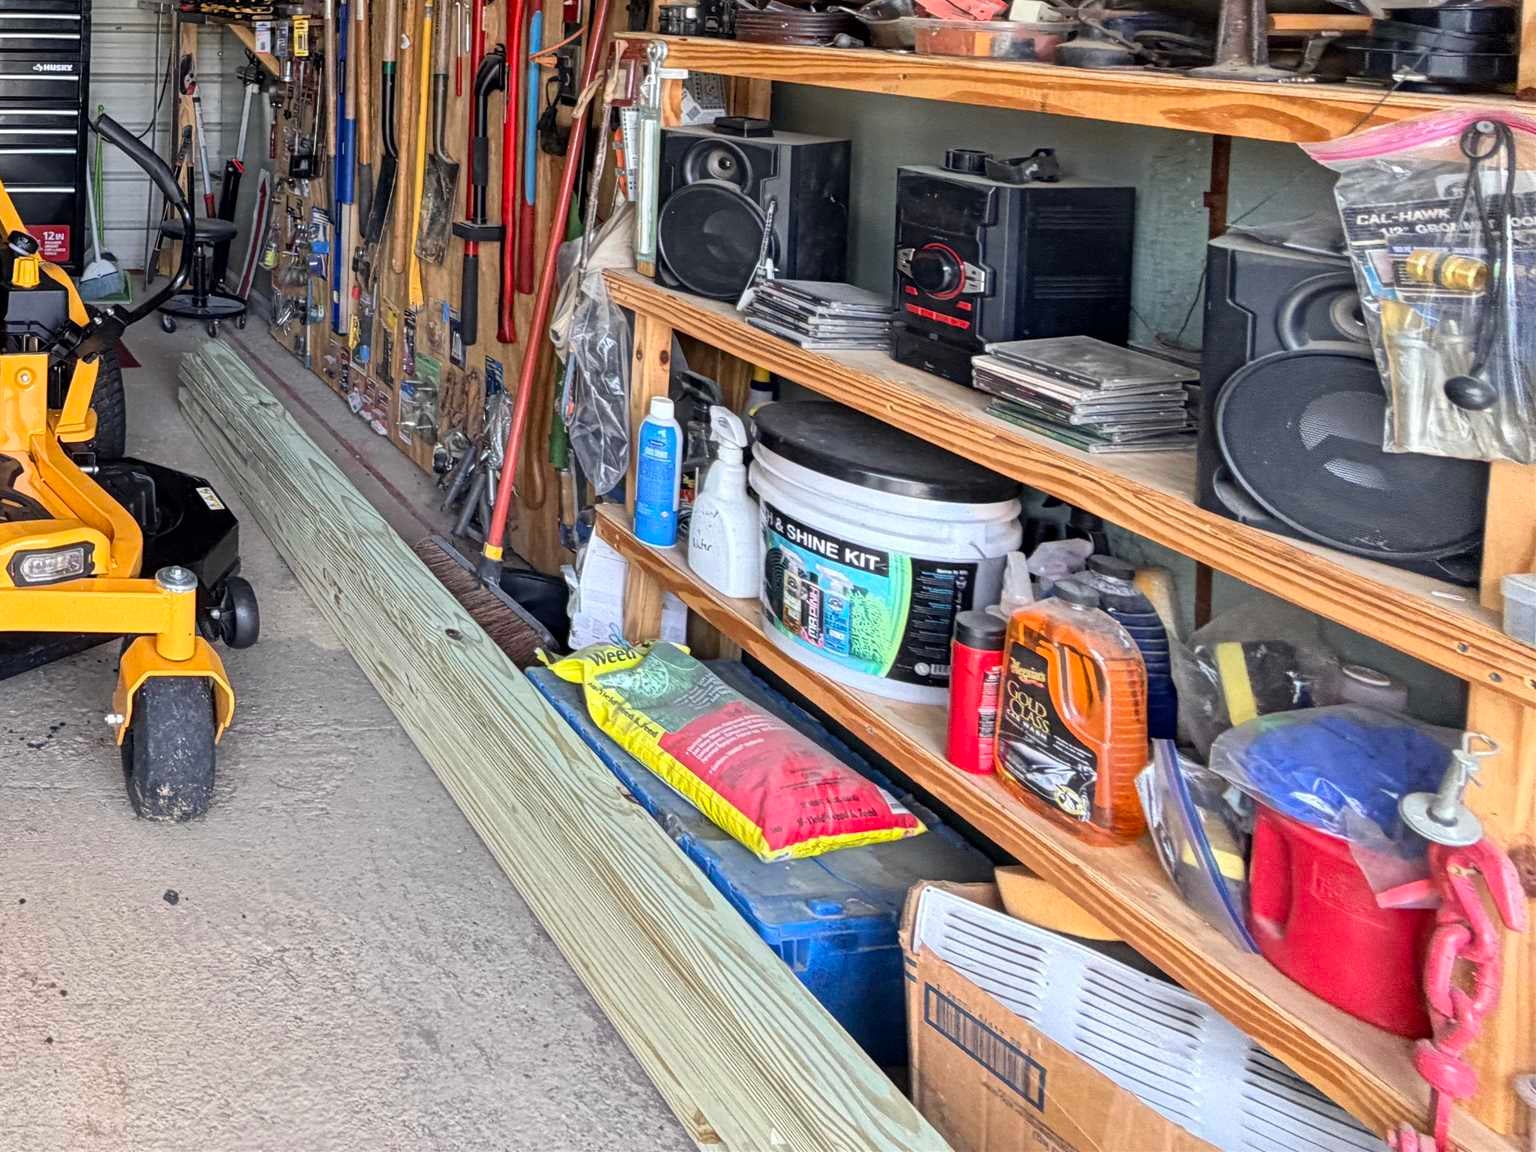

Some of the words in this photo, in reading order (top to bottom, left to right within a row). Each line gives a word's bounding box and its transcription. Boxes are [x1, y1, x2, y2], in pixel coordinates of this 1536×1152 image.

[43, 63, 73, 72] HUSKY
[1356, 207, 1452, 225] CAL-HAWK
[775, 517, 785, 534] &
[786, 524, 840, 559] SHINE
[844, 548, 881, 572] KIT
[1007, 680, 1047, 718] GOLD
[1009, 698, 1050, 735] CLASS
